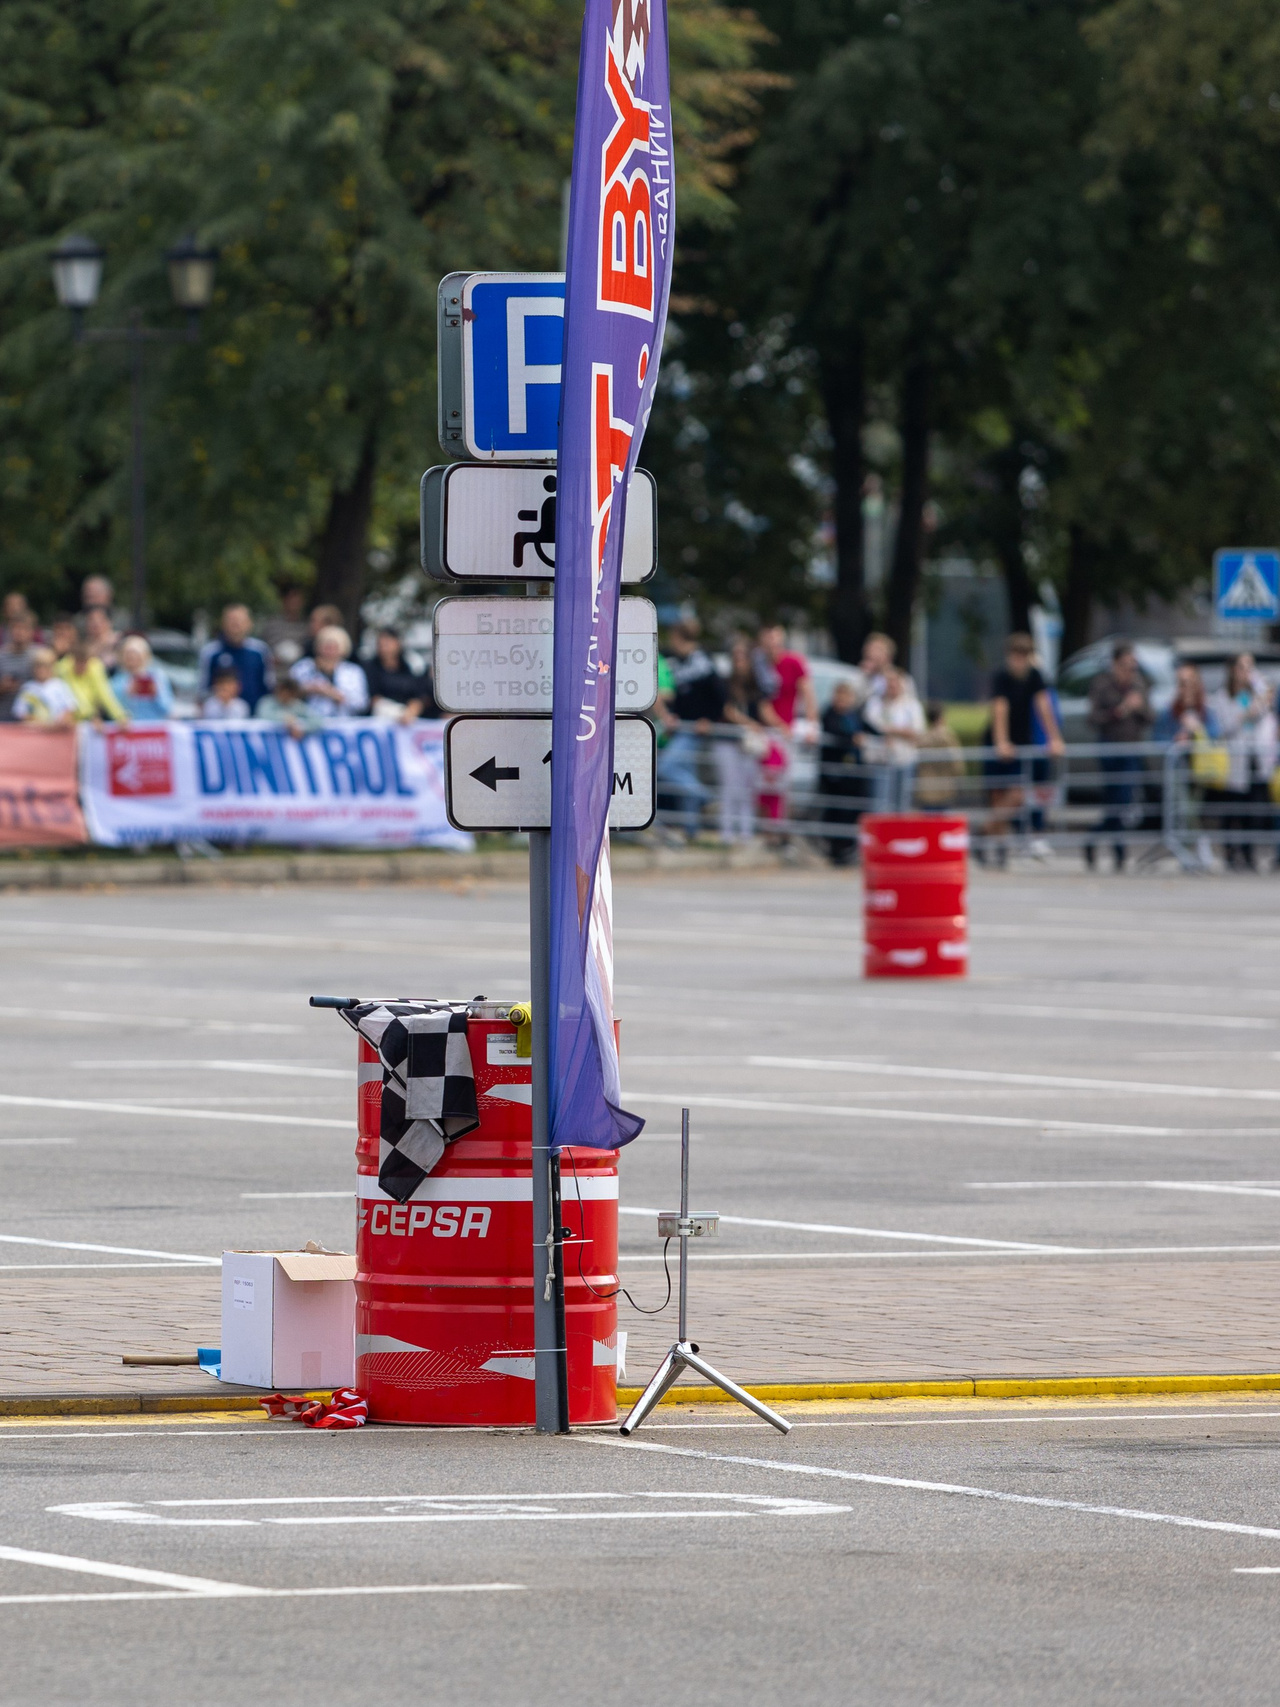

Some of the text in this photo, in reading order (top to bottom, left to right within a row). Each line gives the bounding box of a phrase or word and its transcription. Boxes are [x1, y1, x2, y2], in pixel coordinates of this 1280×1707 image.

[506, 296, 565, 434] P
[447, 644, 545, 671] судьбу,
[456, 681, 486, 697] не
[194, 729, 418, 796] DINITROL
[370, 1203, 493, 1238] CEPSA
